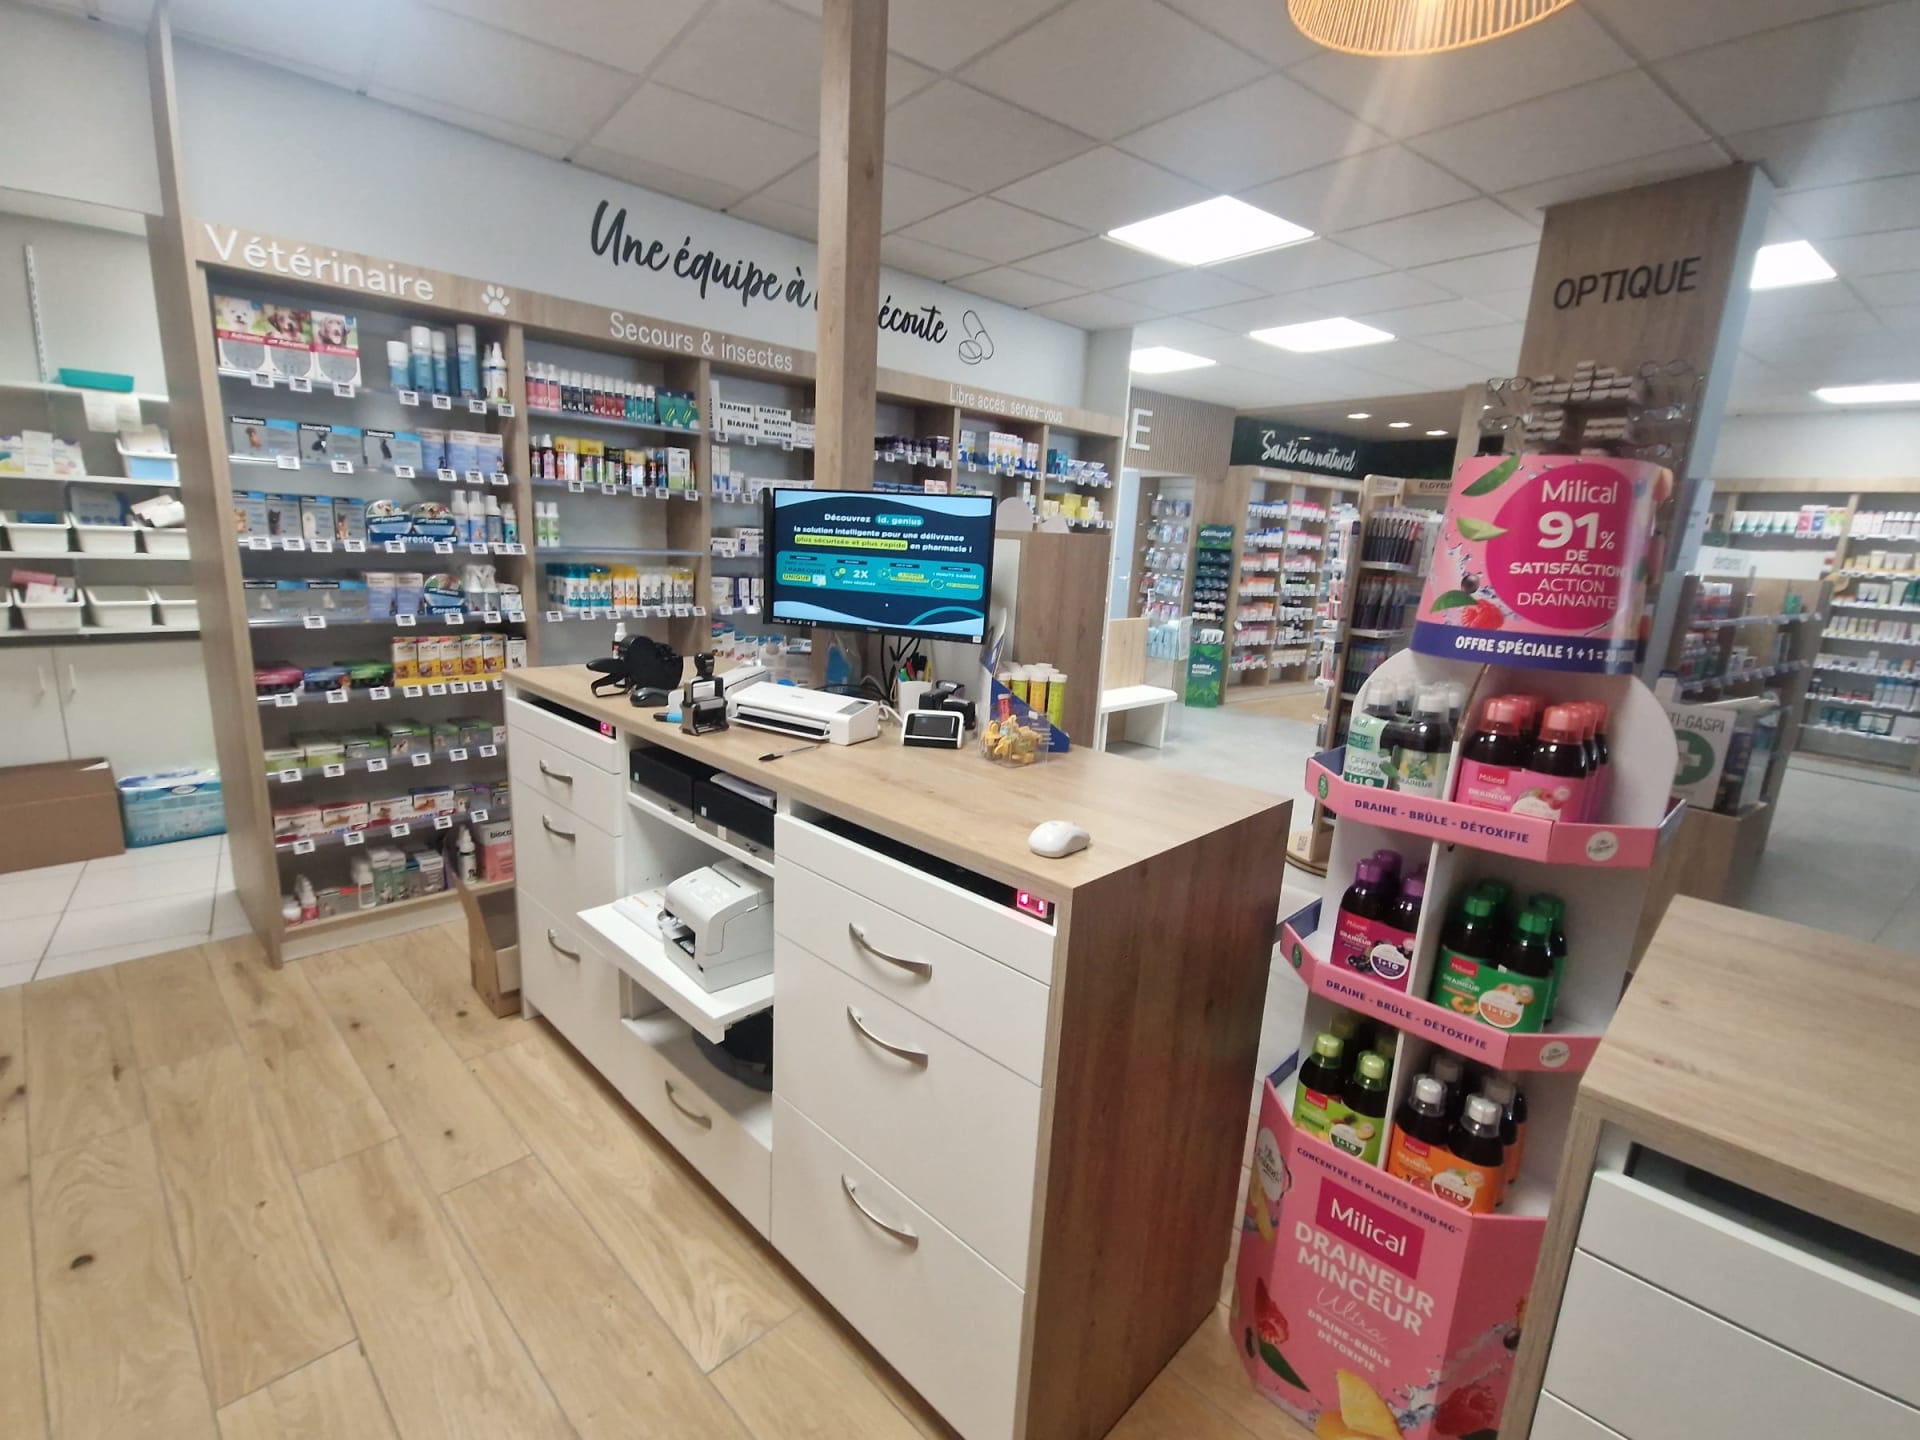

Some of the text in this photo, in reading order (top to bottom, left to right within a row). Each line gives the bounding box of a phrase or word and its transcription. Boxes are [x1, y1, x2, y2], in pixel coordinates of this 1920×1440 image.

[203, 223, 435, 301] Vétérinaire
[591, 199, 948, 344] Une équipe à écoute
[1553, 256, 1702, 310] OPTIQUE
[610, 311, 793, 372] Secours & insectes
[950, 383, 976, 406] Libre
[727, 419, 760, 431] BIAFINE
[763, 418, 792, 429] BIAFINE
[763, 429, 793, 440] BIAFINE
[1261, 430, 1299, 463] Santé
[1298, 447, 1316, 466] au
[1541, 479, 1619, 505] Milical
[824, 513, 871, 523] Découvrez
[891, 517, 923, 527] genius
[395, 534, 435, 544] Seresto
[793, 525, 965, 543] la solution intelligente pour une délivrance
[922, 543, 967, 554] pharmacie
[1564, 549, 1589, 562] DE
[1508, 561, 1627, 578] SATISFACTION
[1537, 577, 1606, 594] ACTION
[1516, 592, 1618, 611] DRAINANTE
[1455, 635, 1496, 652] OFFRE
[1496, 638, 1564, 659] SPÉCIALE
[1669, 711, 1725, 733] TI-GASPI
[1354, 798, 1398, 816] DRAINE
[1408, 810, 1449, 826] BRÛLE
[1460, 819, 1530, 843] DÉTOXIFIE
[1325, 979, 1367, 1001] DRAINE
[1423, 1017, 1488, 1050] DÉTOXIFIE
[1364, 1182, 1409, 1210] PLANTES
[1330, 1197, 1407, 1257] Milical
[1295, 1220, 1435, 1319] DRAINEUR
[1297, 1246, 1424, 1337] MINCEUR
[1317, 1328, 1376, 1373] DÉTOXIFIE
